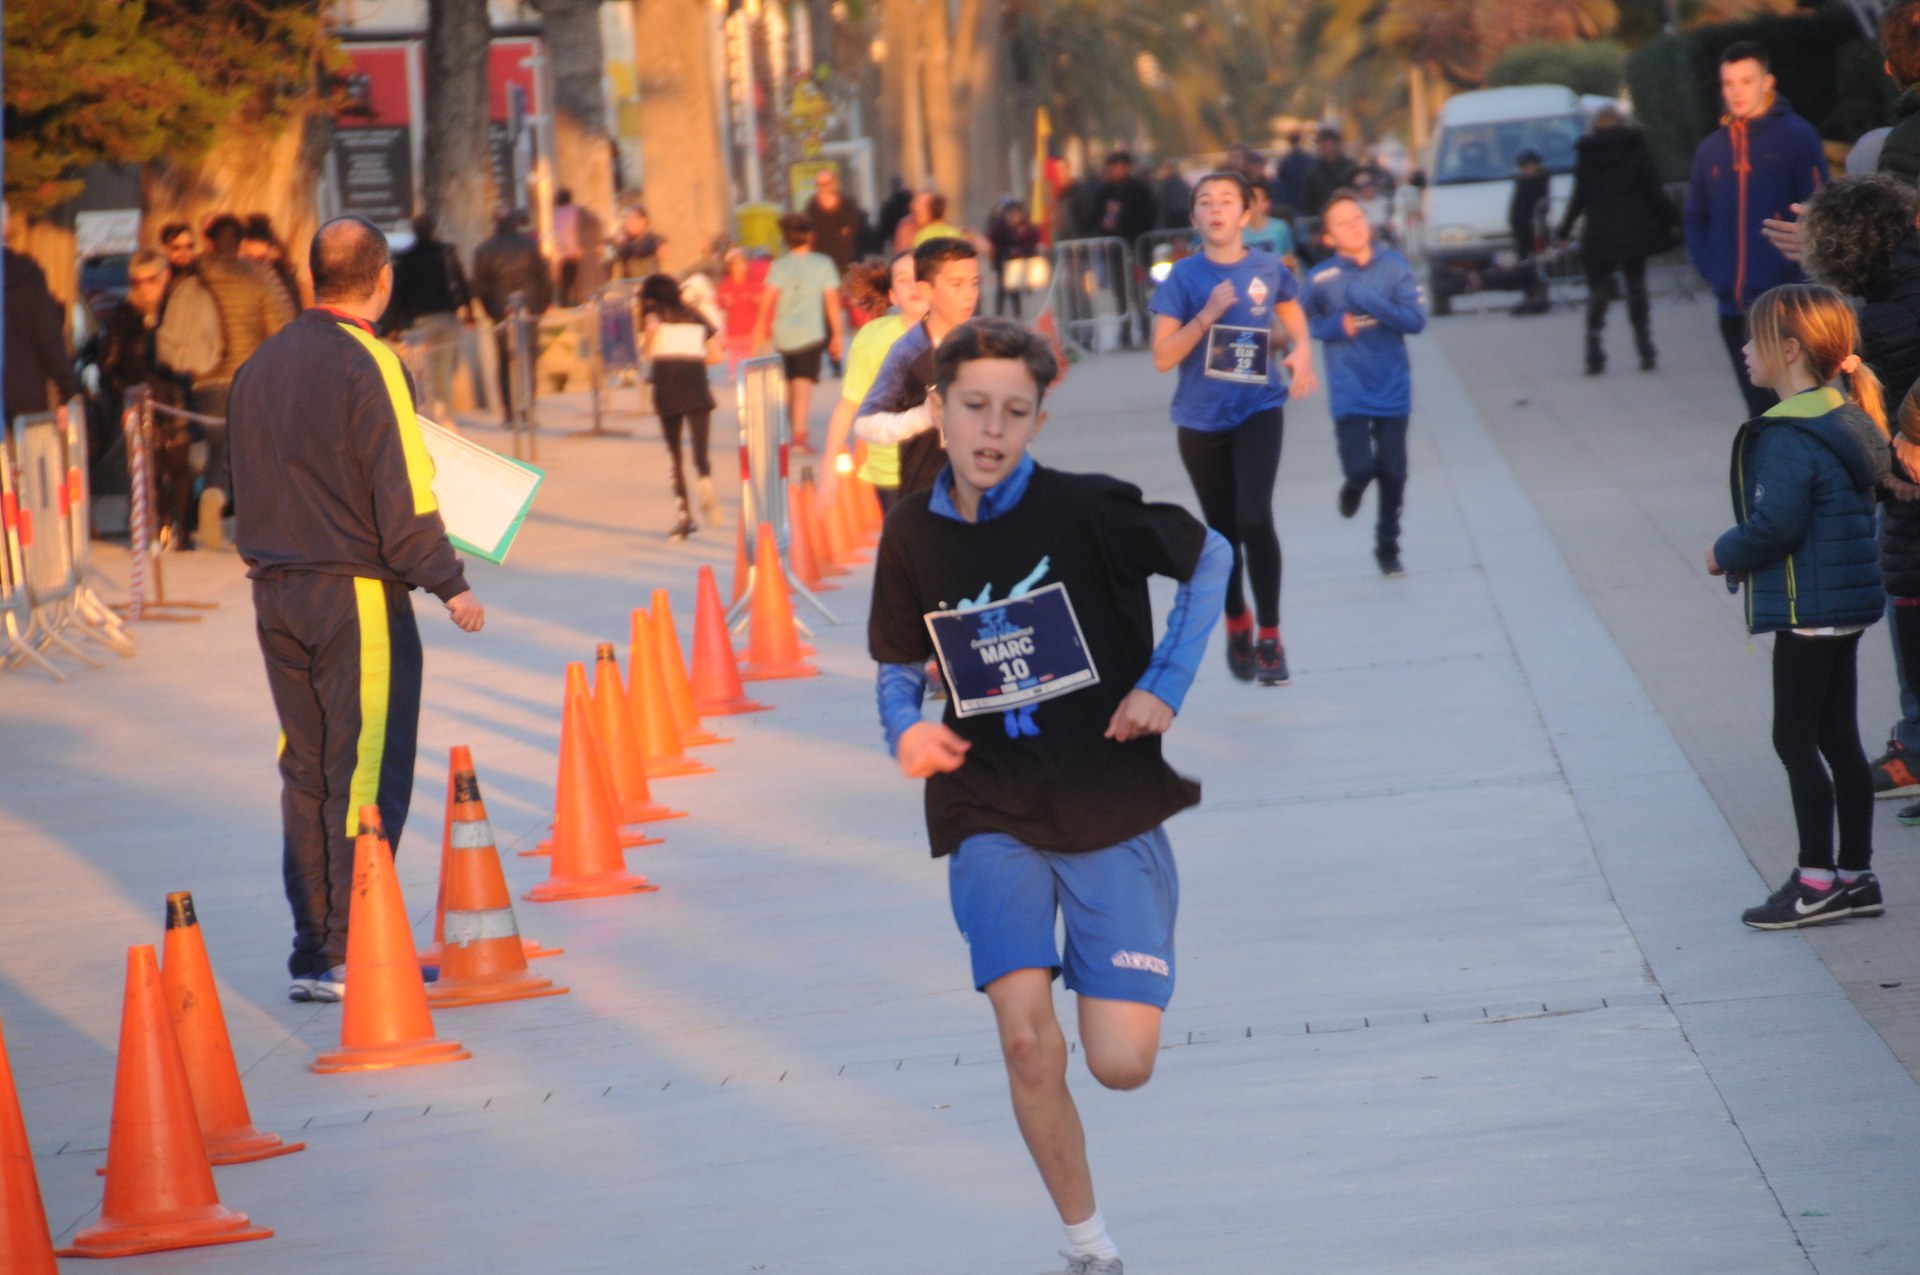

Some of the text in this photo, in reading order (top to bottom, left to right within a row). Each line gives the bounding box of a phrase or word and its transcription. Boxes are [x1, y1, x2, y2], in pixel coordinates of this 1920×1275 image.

[1236, 358, 1252, 369] 19
[979, 636, 1035, 665] MARC
[999, 658, 1030, 683] 10
